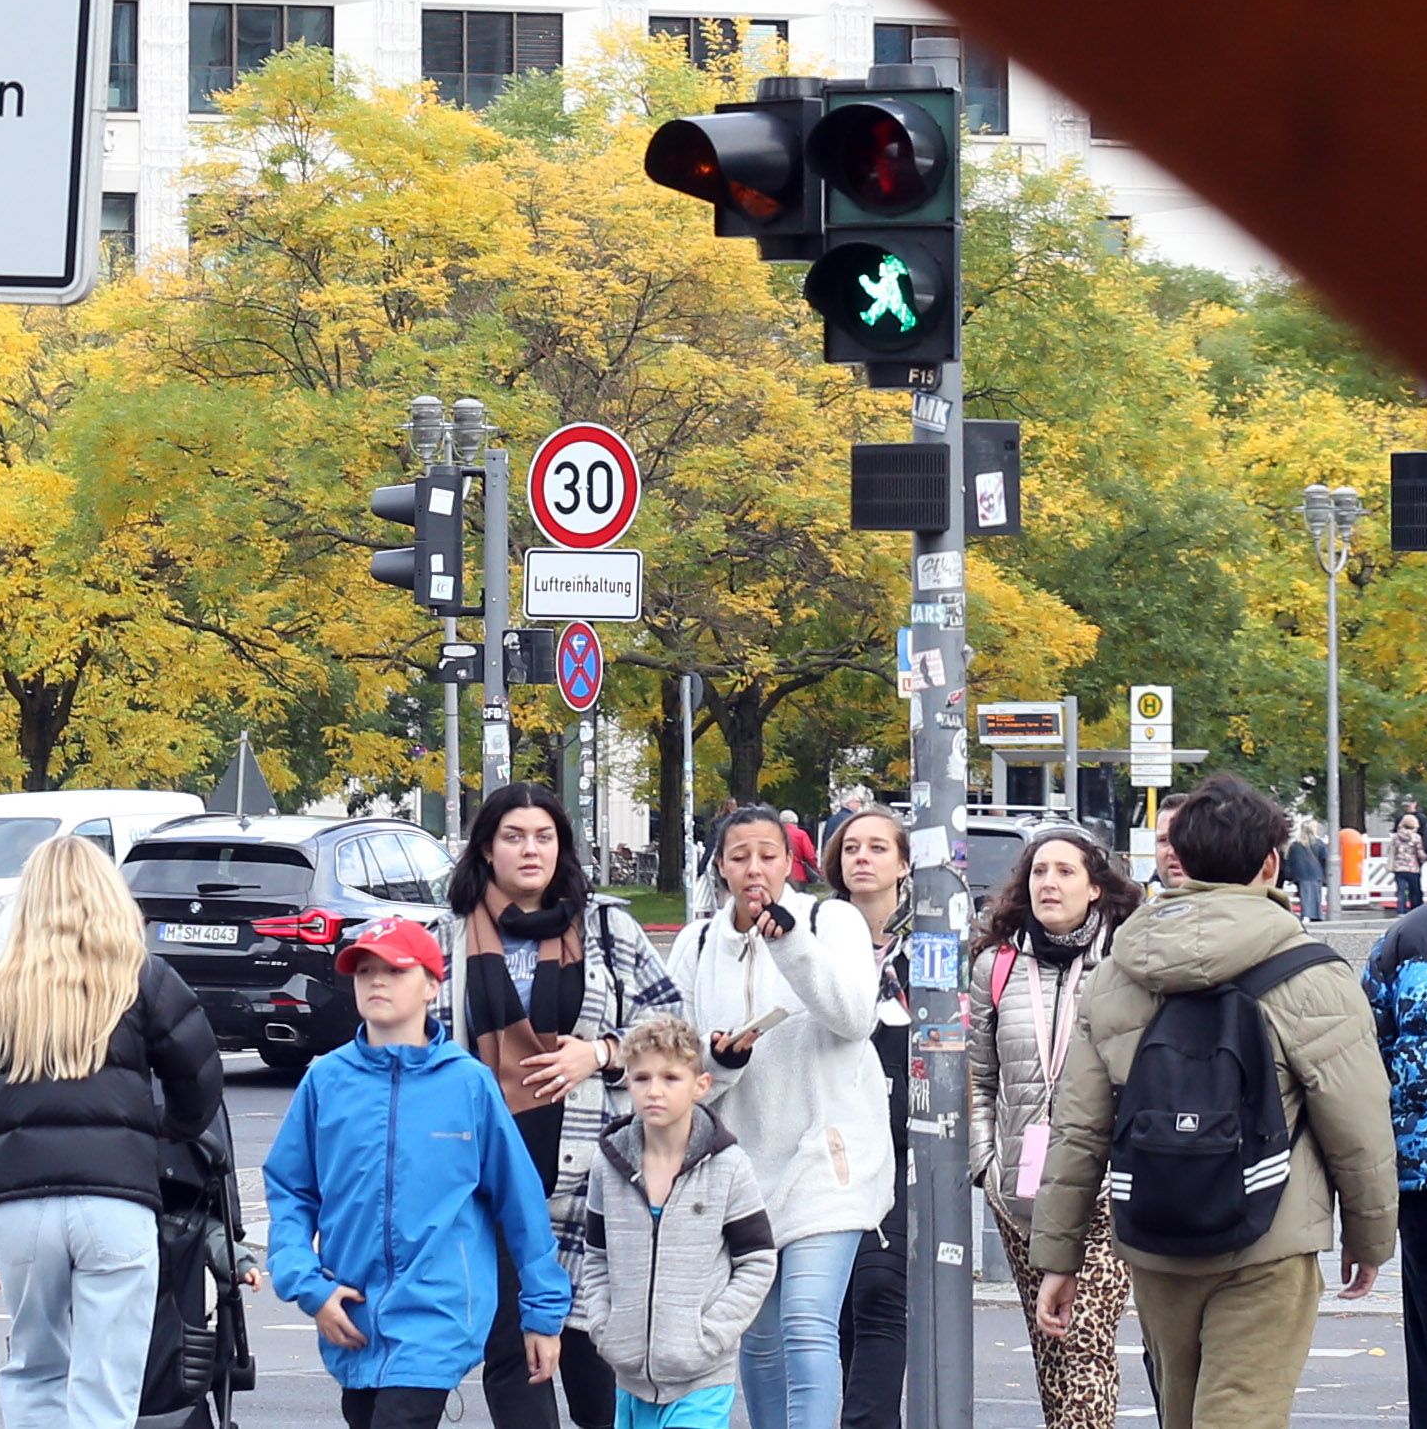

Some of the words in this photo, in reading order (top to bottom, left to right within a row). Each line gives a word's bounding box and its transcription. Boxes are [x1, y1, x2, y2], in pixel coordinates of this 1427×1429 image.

[908, 368, 934, 385] F15
[554, 460, 613, 515] 30
[534, 575, 632, 598] Luftreinhaltung
[184, 926, 201, 940] SM
[204, 927, 236, 941] 4043
